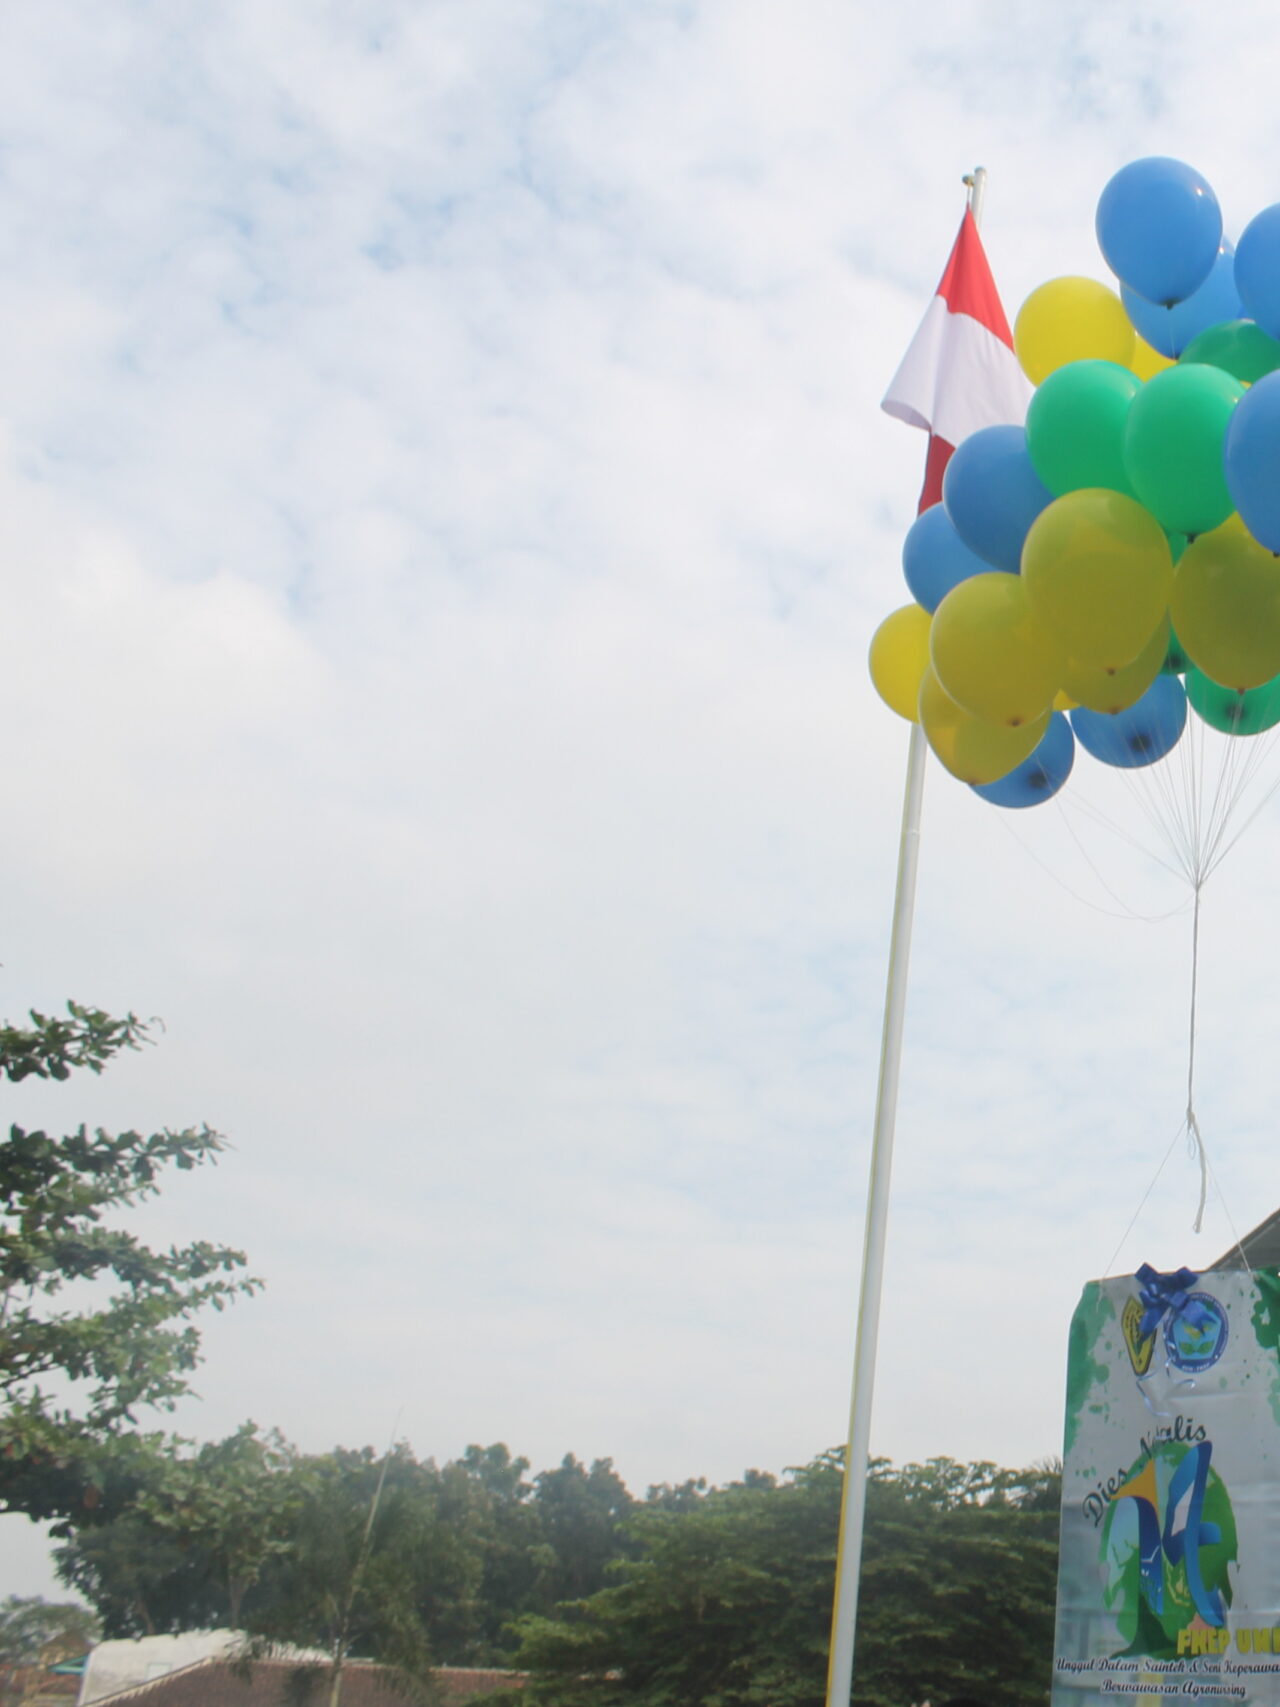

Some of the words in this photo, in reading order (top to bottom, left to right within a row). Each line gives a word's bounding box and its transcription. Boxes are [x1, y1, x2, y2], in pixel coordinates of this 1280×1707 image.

[1082, 1468, 1128, 1528] Dies
[1177, 1628, 1230, 1655] FKEP
[1056, 1657, 1095, 1673] Unggul
[1098, 1658, 1139, 1672] Dalam
[1189, 1661, 1198, 1673] &
[1102, 1679, 1178, 1694] Berwawasan
